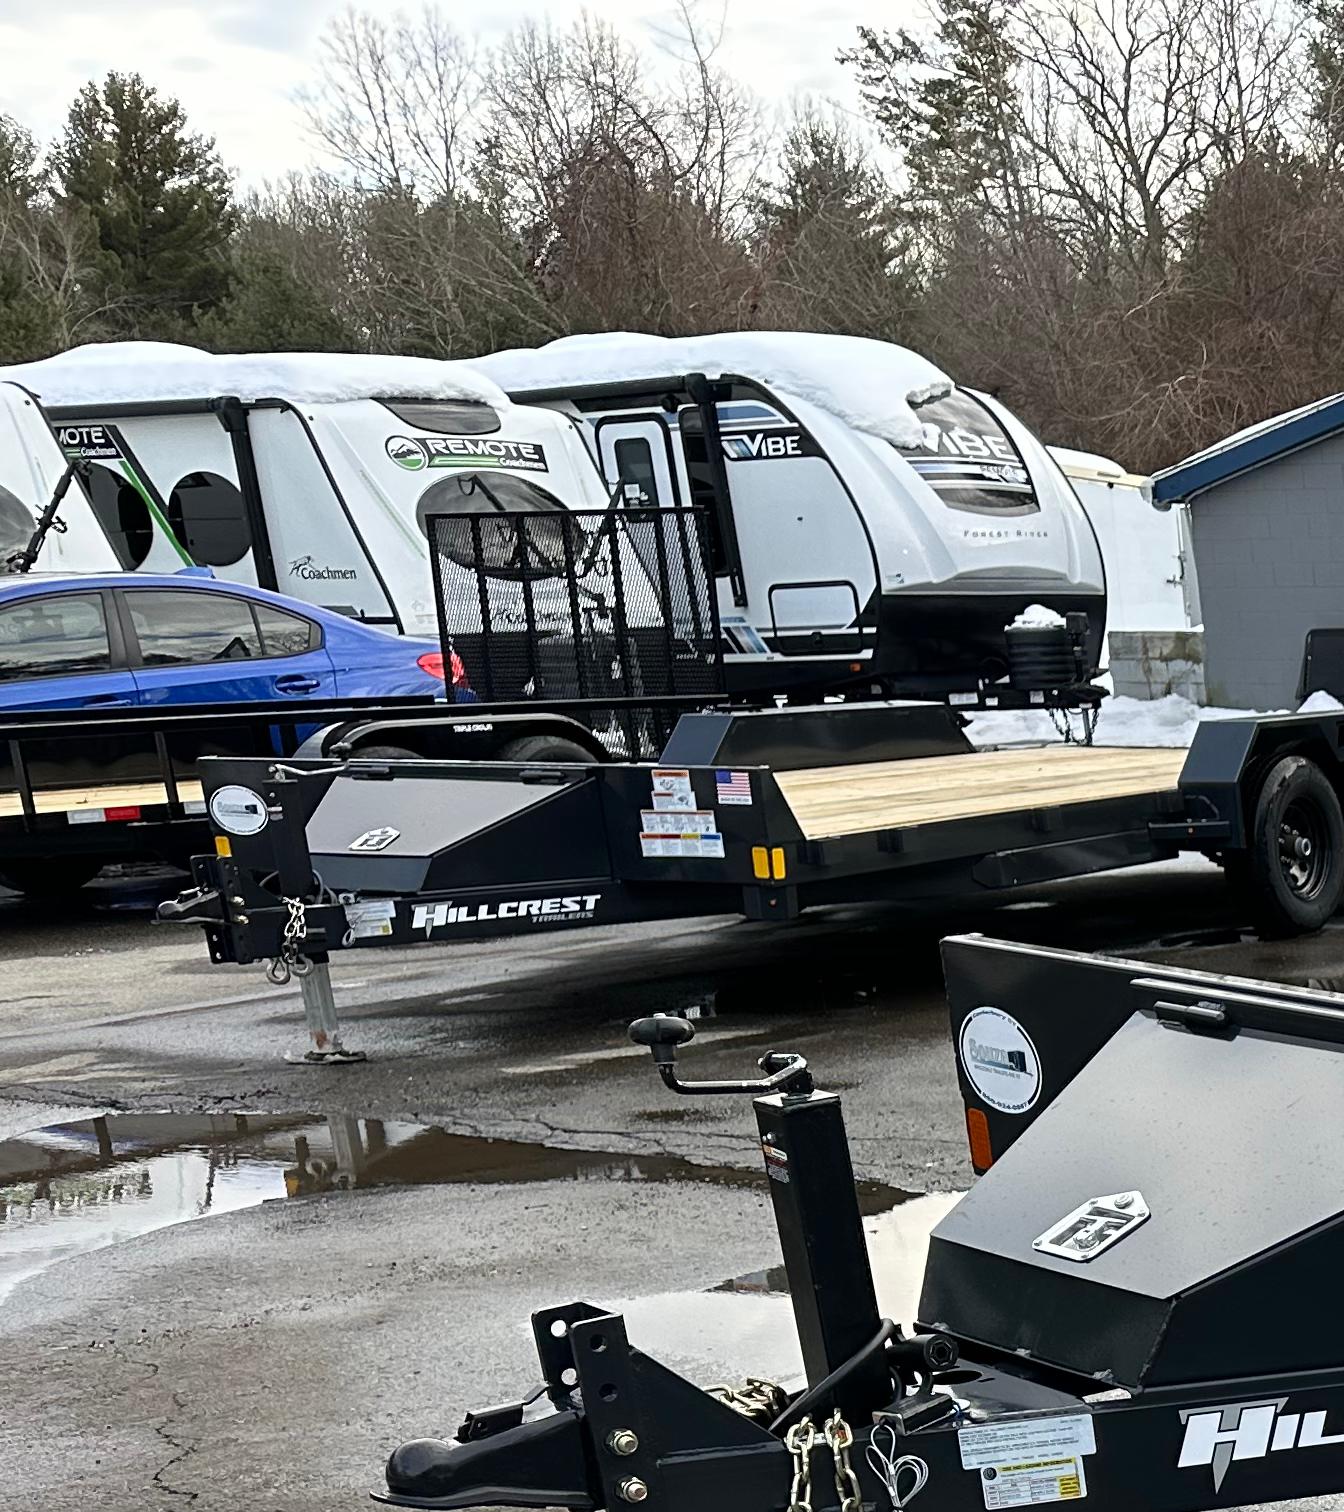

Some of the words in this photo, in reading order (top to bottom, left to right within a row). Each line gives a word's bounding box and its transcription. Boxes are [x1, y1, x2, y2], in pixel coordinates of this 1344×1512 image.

[425, 439, 540, 460] REMOTE
[735, 432, 802, 458] VIBE
[301, 566, 358, 580] Coachmen
[411, 895, 602, 931] HILLCREST
[531, 910, 595, 924] TRAILERS
